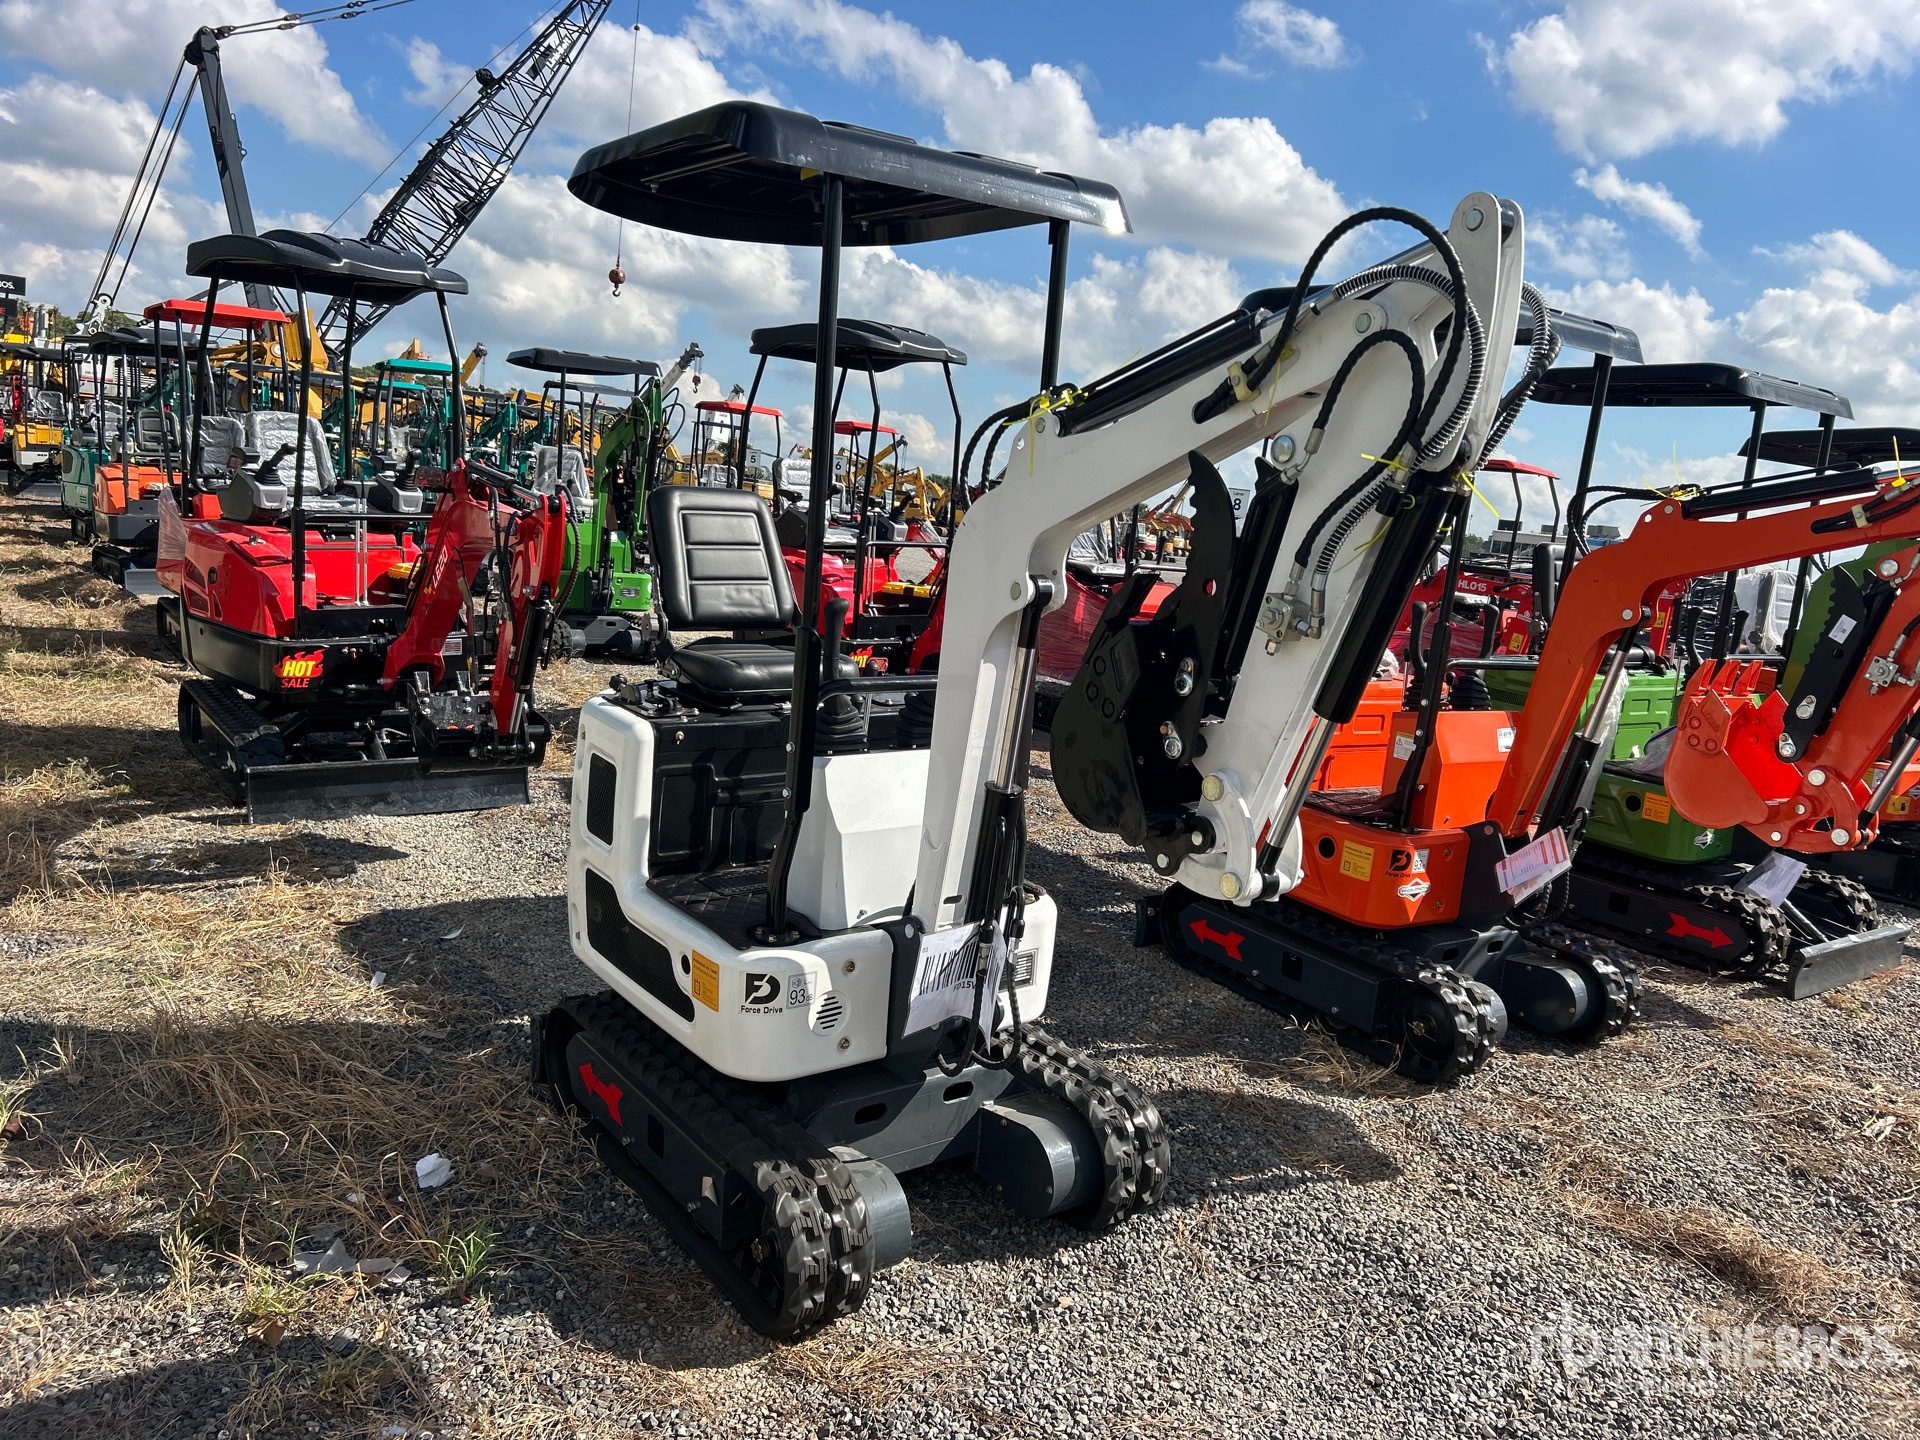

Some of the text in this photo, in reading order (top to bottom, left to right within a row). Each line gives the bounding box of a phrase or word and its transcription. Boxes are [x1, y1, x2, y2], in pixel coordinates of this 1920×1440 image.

[750, 455, 756, 463] 5
[835, 461, 842, 470] 6
[1233, 498, 1242, 511] 8
[283, 660, 316, 677] HOT
[280, 678, 311, 689] SALE
[789, 988, 806, 1006] 93
[740, 1005, 783, 1014] Force Drive
